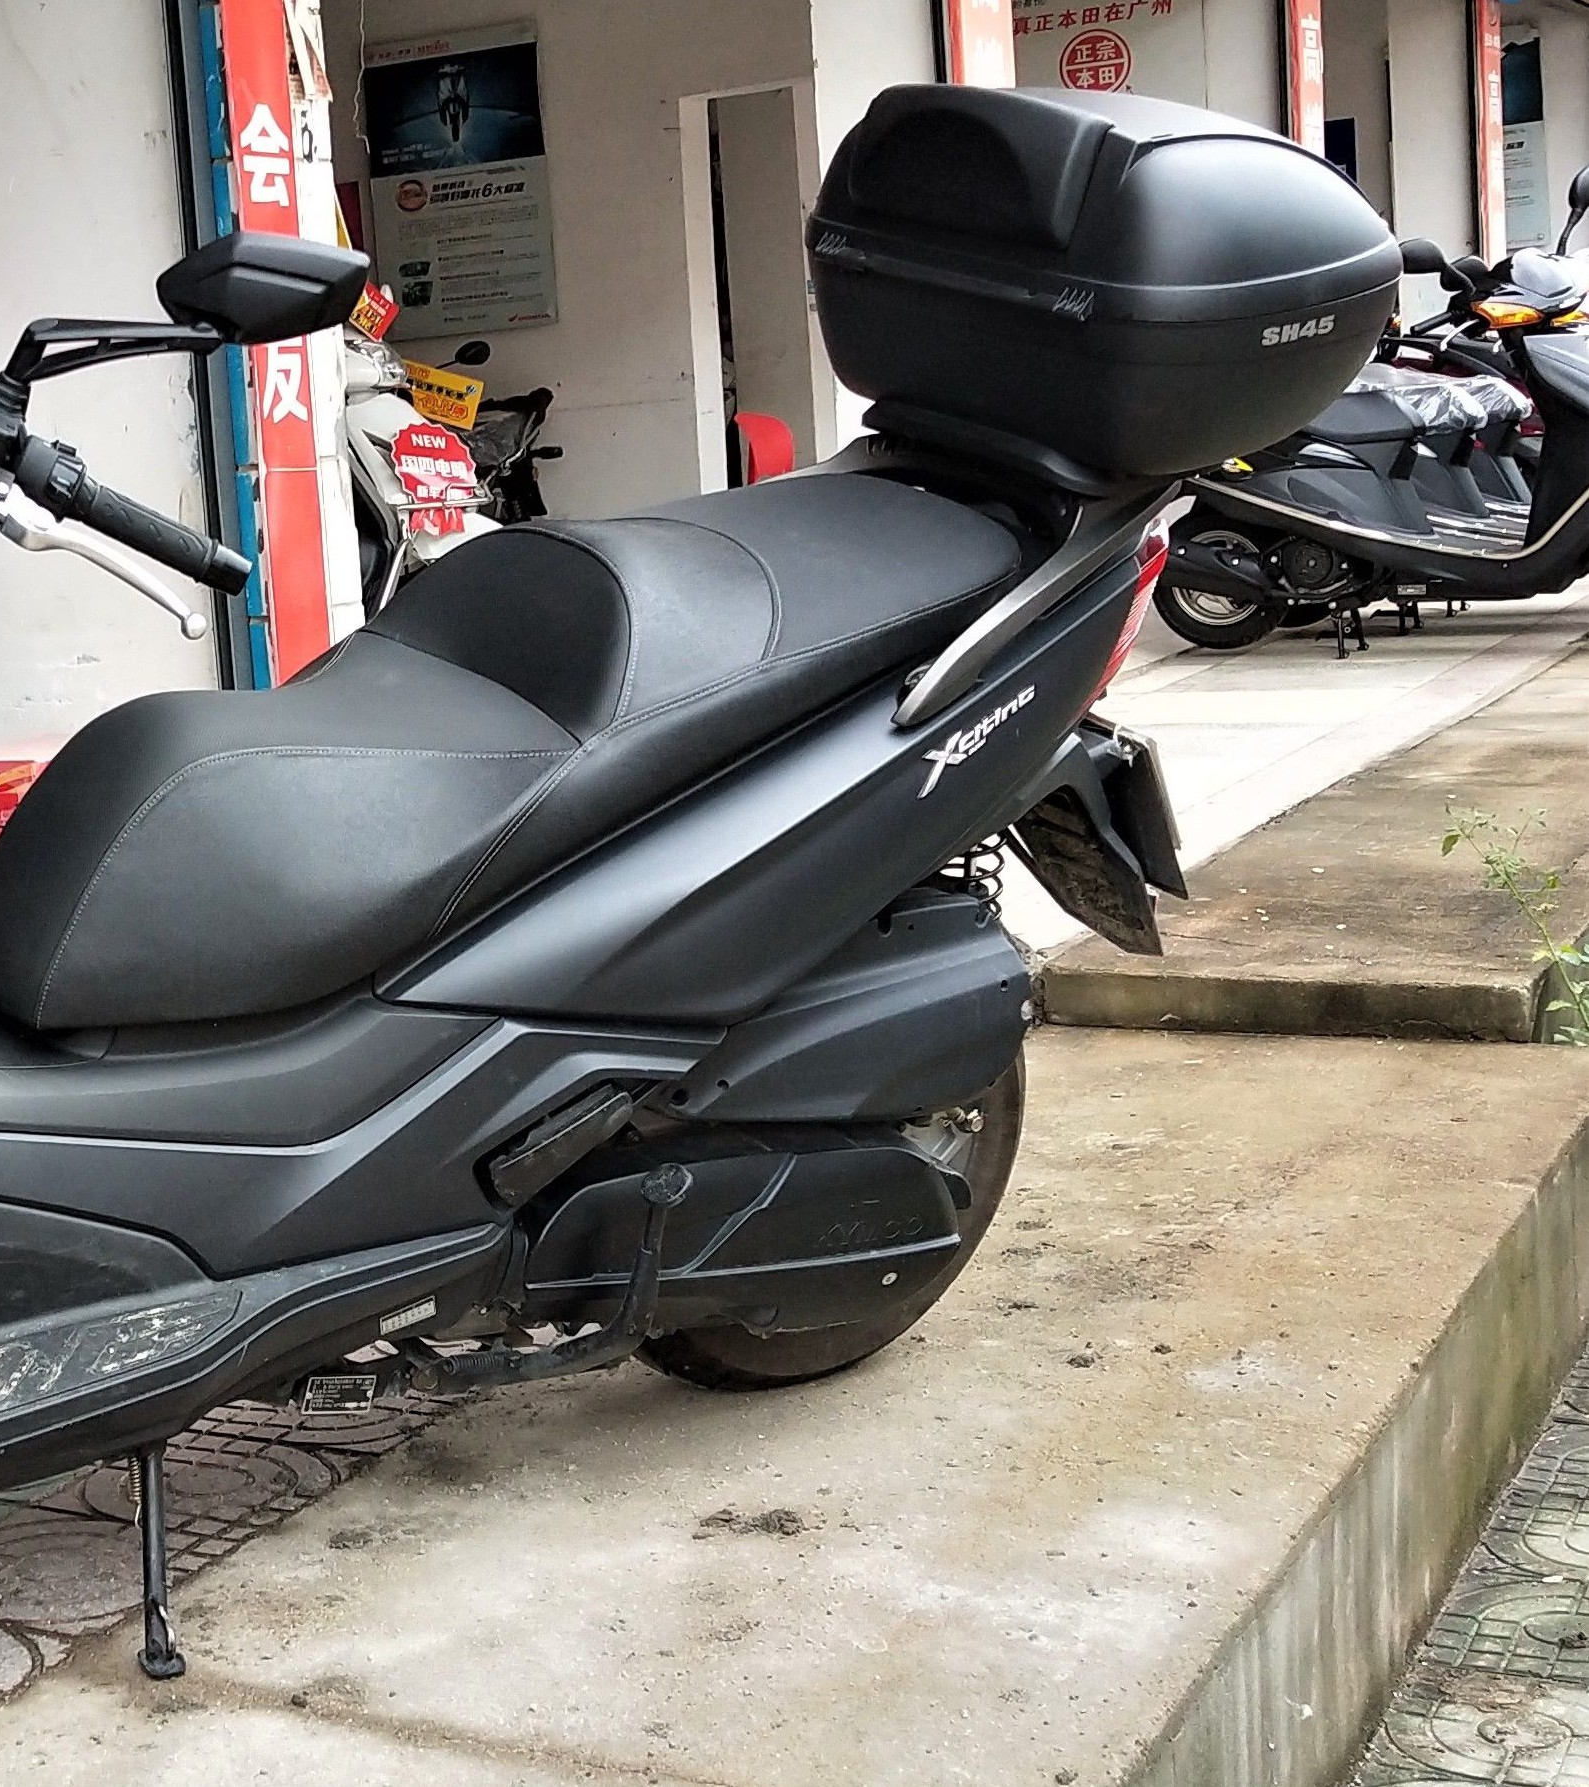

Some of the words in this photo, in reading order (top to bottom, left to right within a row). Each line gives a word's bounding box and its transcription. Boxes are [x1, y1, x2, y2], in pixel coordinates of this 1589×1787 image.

[1013, 0, 1172, 36] 真正本田在广州
[1074, 41, 1116, 62] 正宗
[1076, 67, 1116, 89] 本田
[1260, 313, 1335, 348] SH45
[411, 432, 447, 450] NEW
